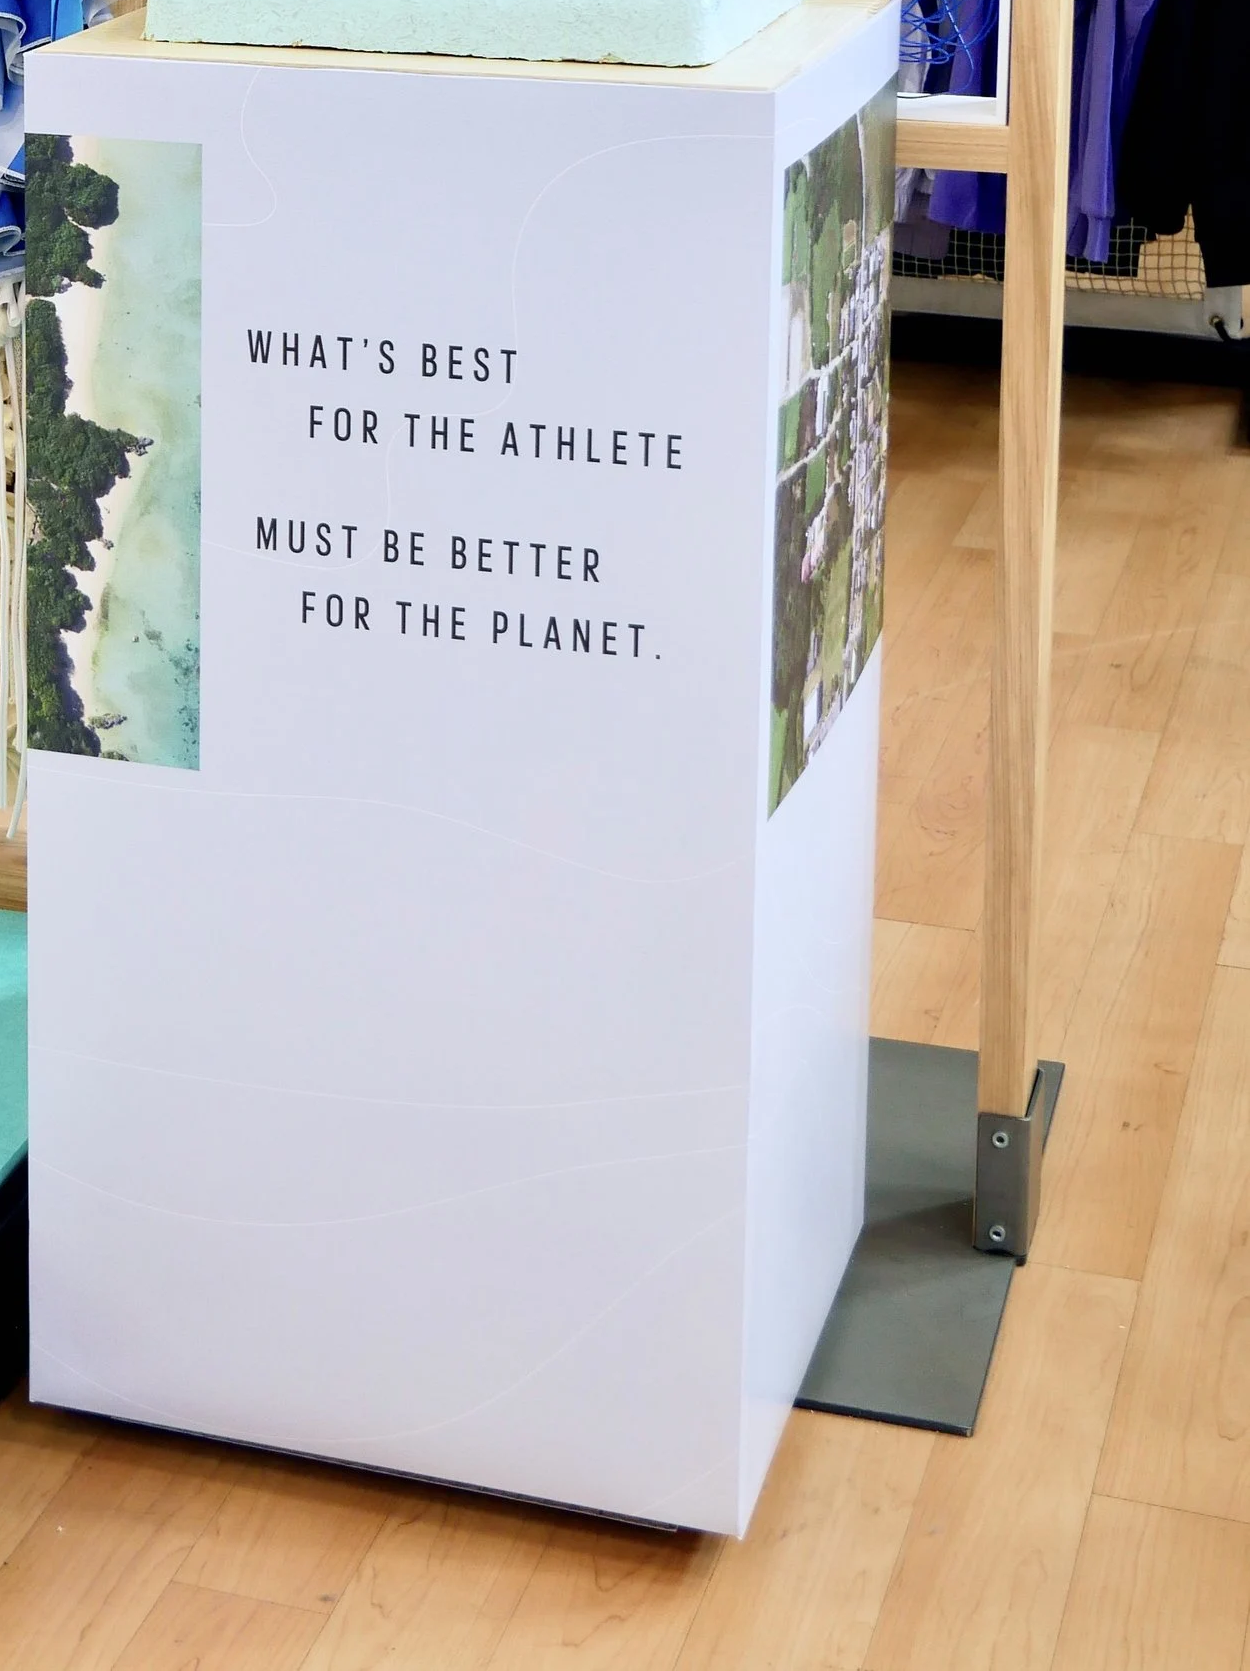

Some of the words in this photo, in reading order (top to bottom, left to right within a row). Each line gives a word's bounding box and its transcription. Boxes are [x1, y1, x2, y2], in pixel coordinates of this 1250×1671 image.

[247, 329, 395, 375] WHAT'S
[421, 343, 517, 384] BEST
[309, 405, 379, 444] FOR
[404, 413, 475, 453] THE
[501, 421, 682, 470] ATHLETE
[256, 516, 358, 559] MUST
[383, 529, 425, 566] BE
[451, 535, 600, 583] BETTER
[301, 591, 371, 630] FOR
[395, 600, 466, 641] THE
[492, 610, 661, 660] PLANET.
